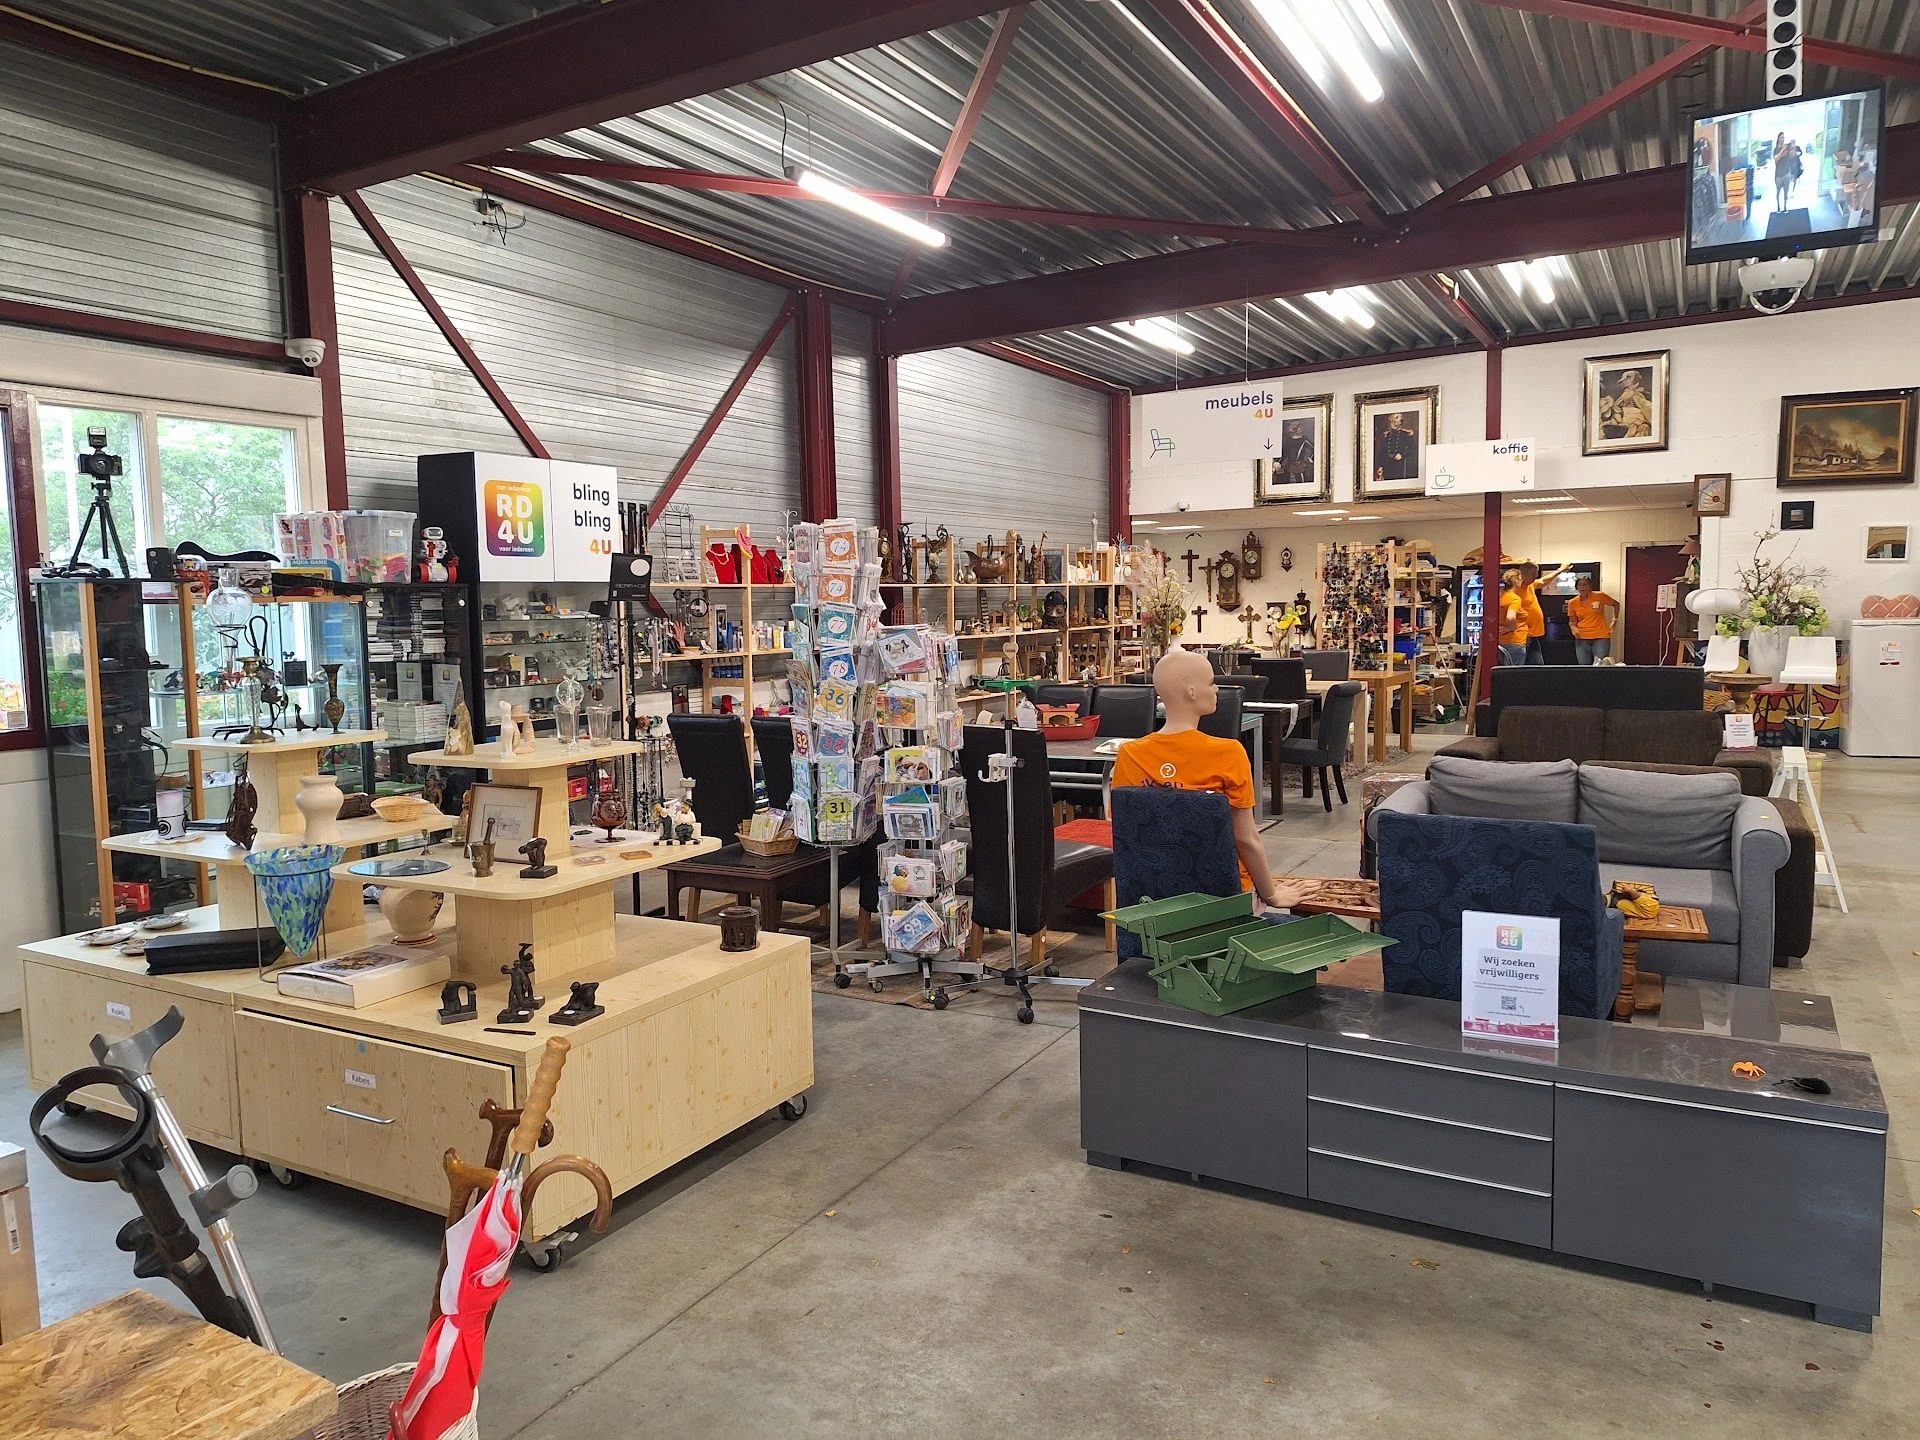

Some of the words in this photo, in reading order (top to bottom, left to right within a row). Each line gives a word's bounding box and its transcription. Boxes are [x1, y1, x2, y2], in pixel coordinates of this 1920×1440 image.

[1205, 391, 1273, 409] meubels
[1254, 408, 1274, 419] 4U
[1493, 443, 1528, 454] koffie
[1514, 454, 1528, 462] 4U
[573, 483, 610, 506] bling
[496, 493, 533, 519] RD
[574, 510, 611, 532] bling
[497, 519, 534, 545] 4U
[589, 539, 612, 555] 4U
[829, 582, 843, 594] 74
[830, 619, 845, 630] 77
[832, 662, 846, 675] 78
[825, 688, 845, 706] 36
[796, 733, 808, 749] 32
[822, 735, 845, 752] 38
[820, 762, 848, 788] 30
[829, 801, 846, 814] 31
[1500, 929, 1518, 938] RD
[1500, 938, 1518, 947] 4U
[1483, 955, 1499, 967] Wij
[1501, 958, 1536, 968] zoeken
[1479, 967, 1540, 981] vrijwilligers
[351, 1073, 371, 1086] Kabels
